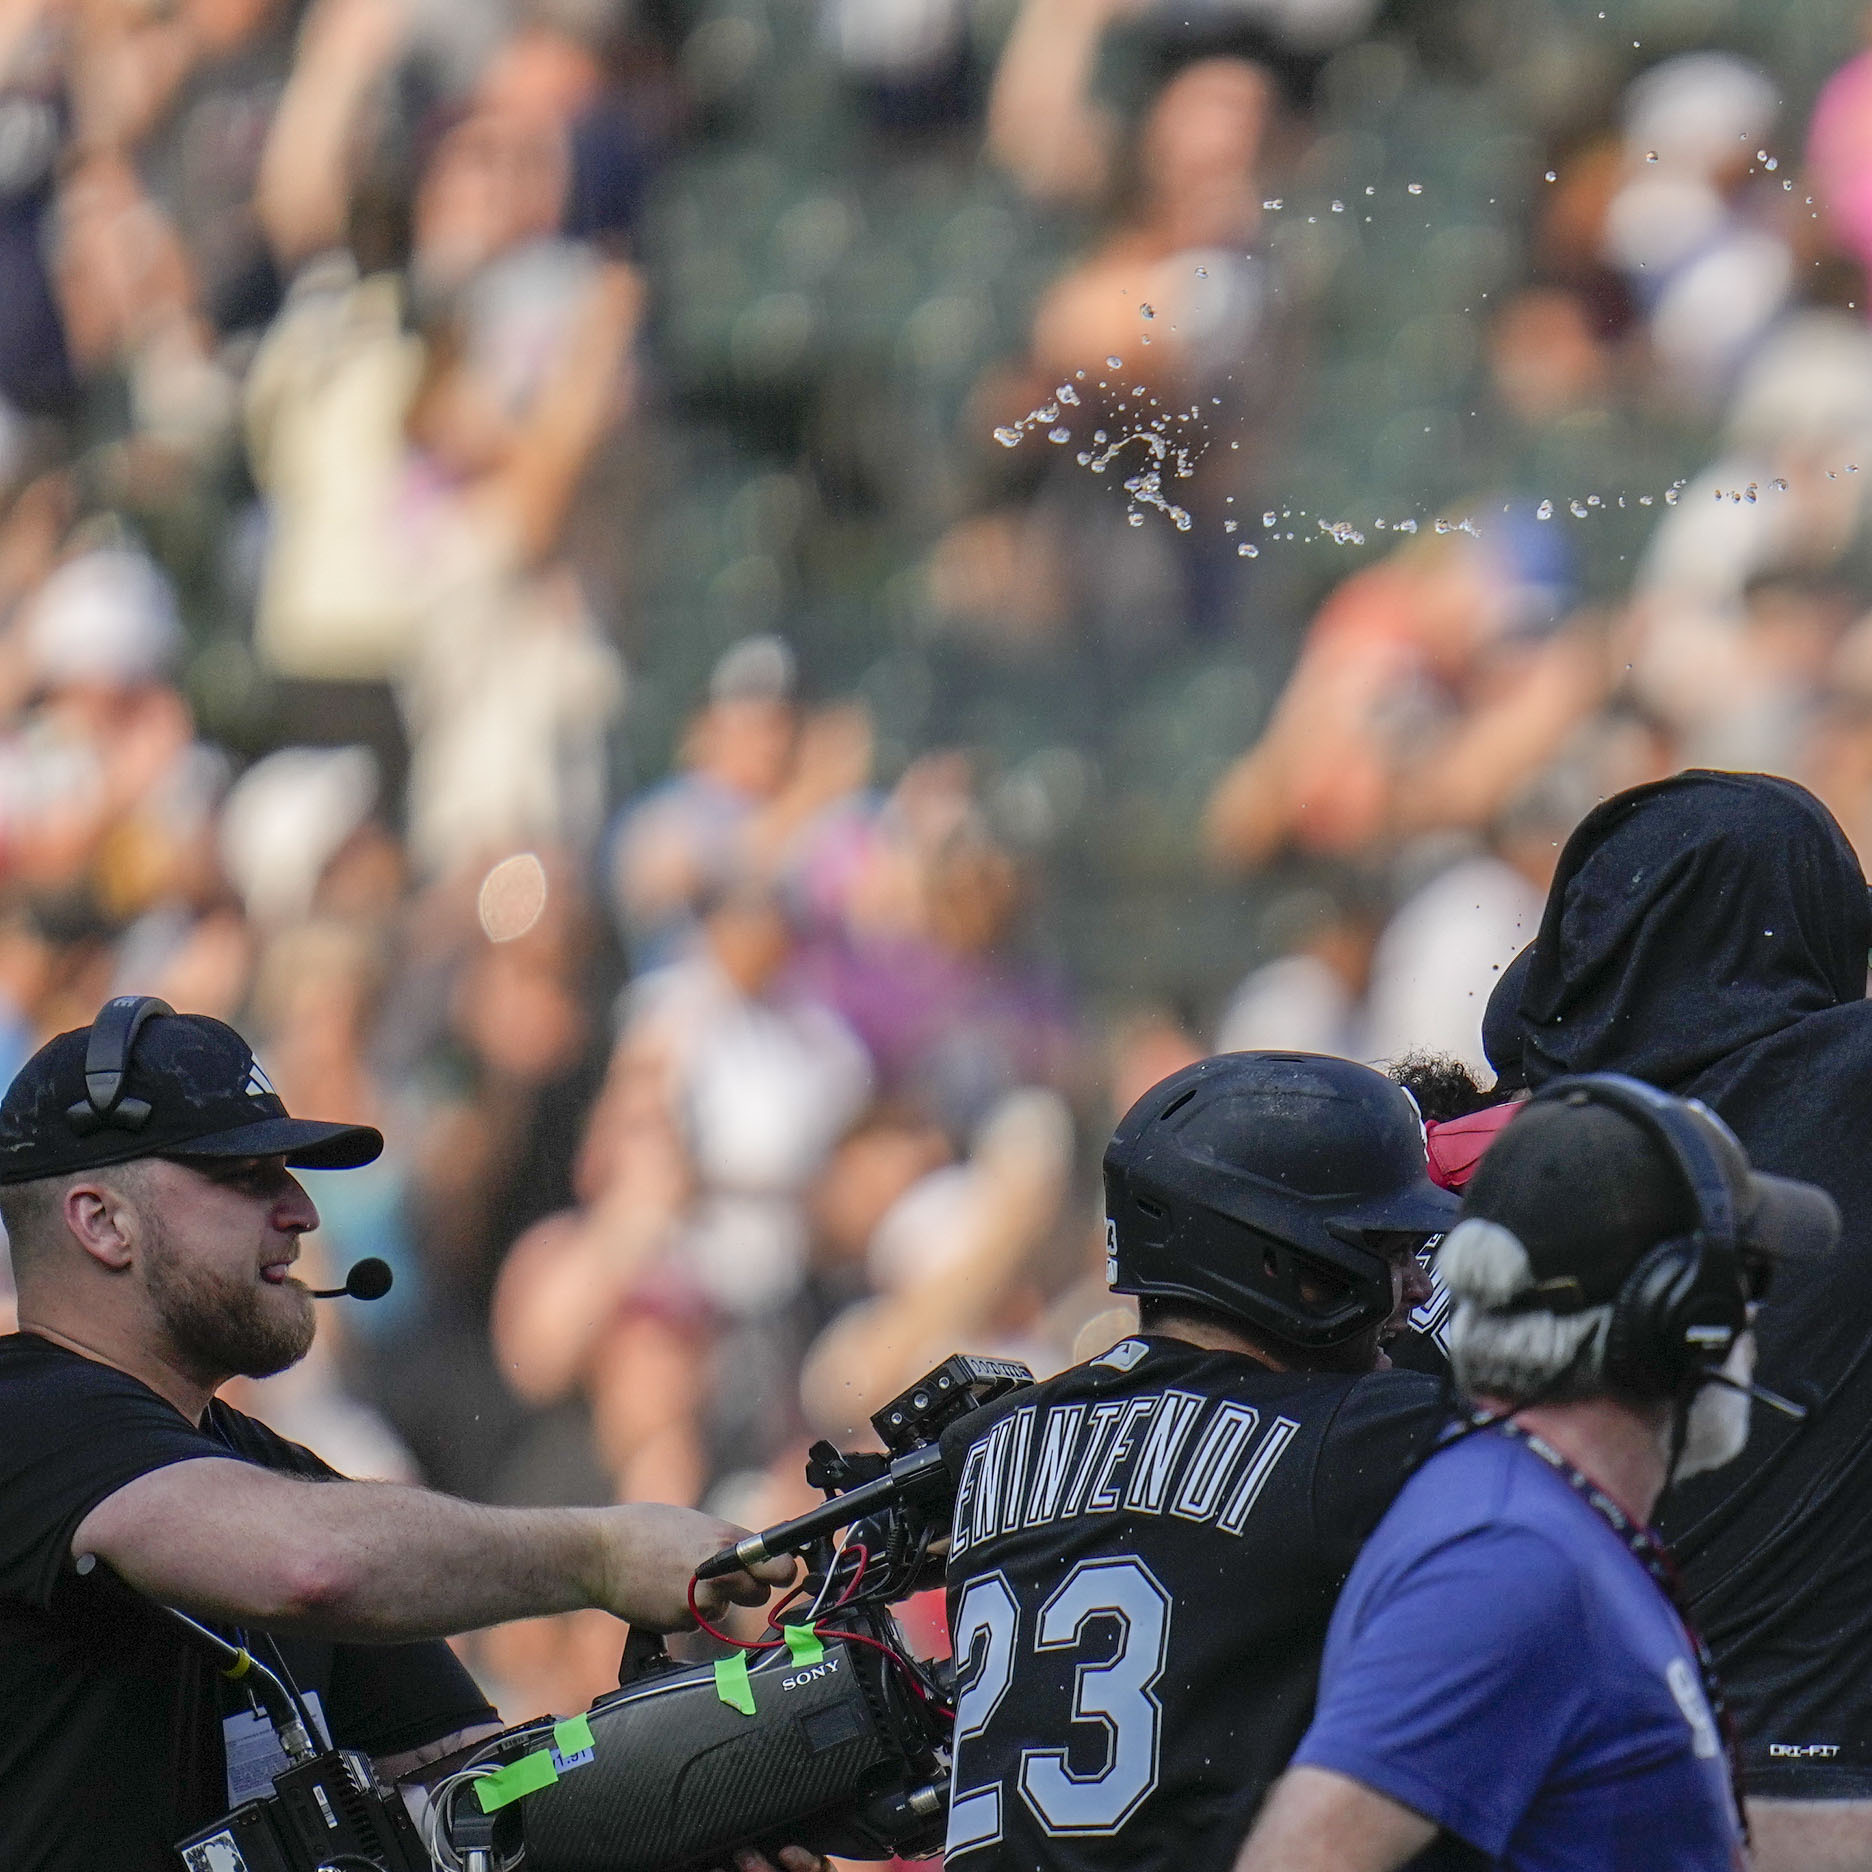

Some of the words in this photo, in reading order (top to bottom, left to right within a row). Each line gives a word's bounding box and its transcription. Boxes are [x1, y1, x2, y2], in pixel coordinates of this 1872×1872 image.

[782, 1659, 839, 1692] SONY
[943, 1554, 1172, 1868] 23
[1769, 1743, 1840, 1758] DRI-FIT
